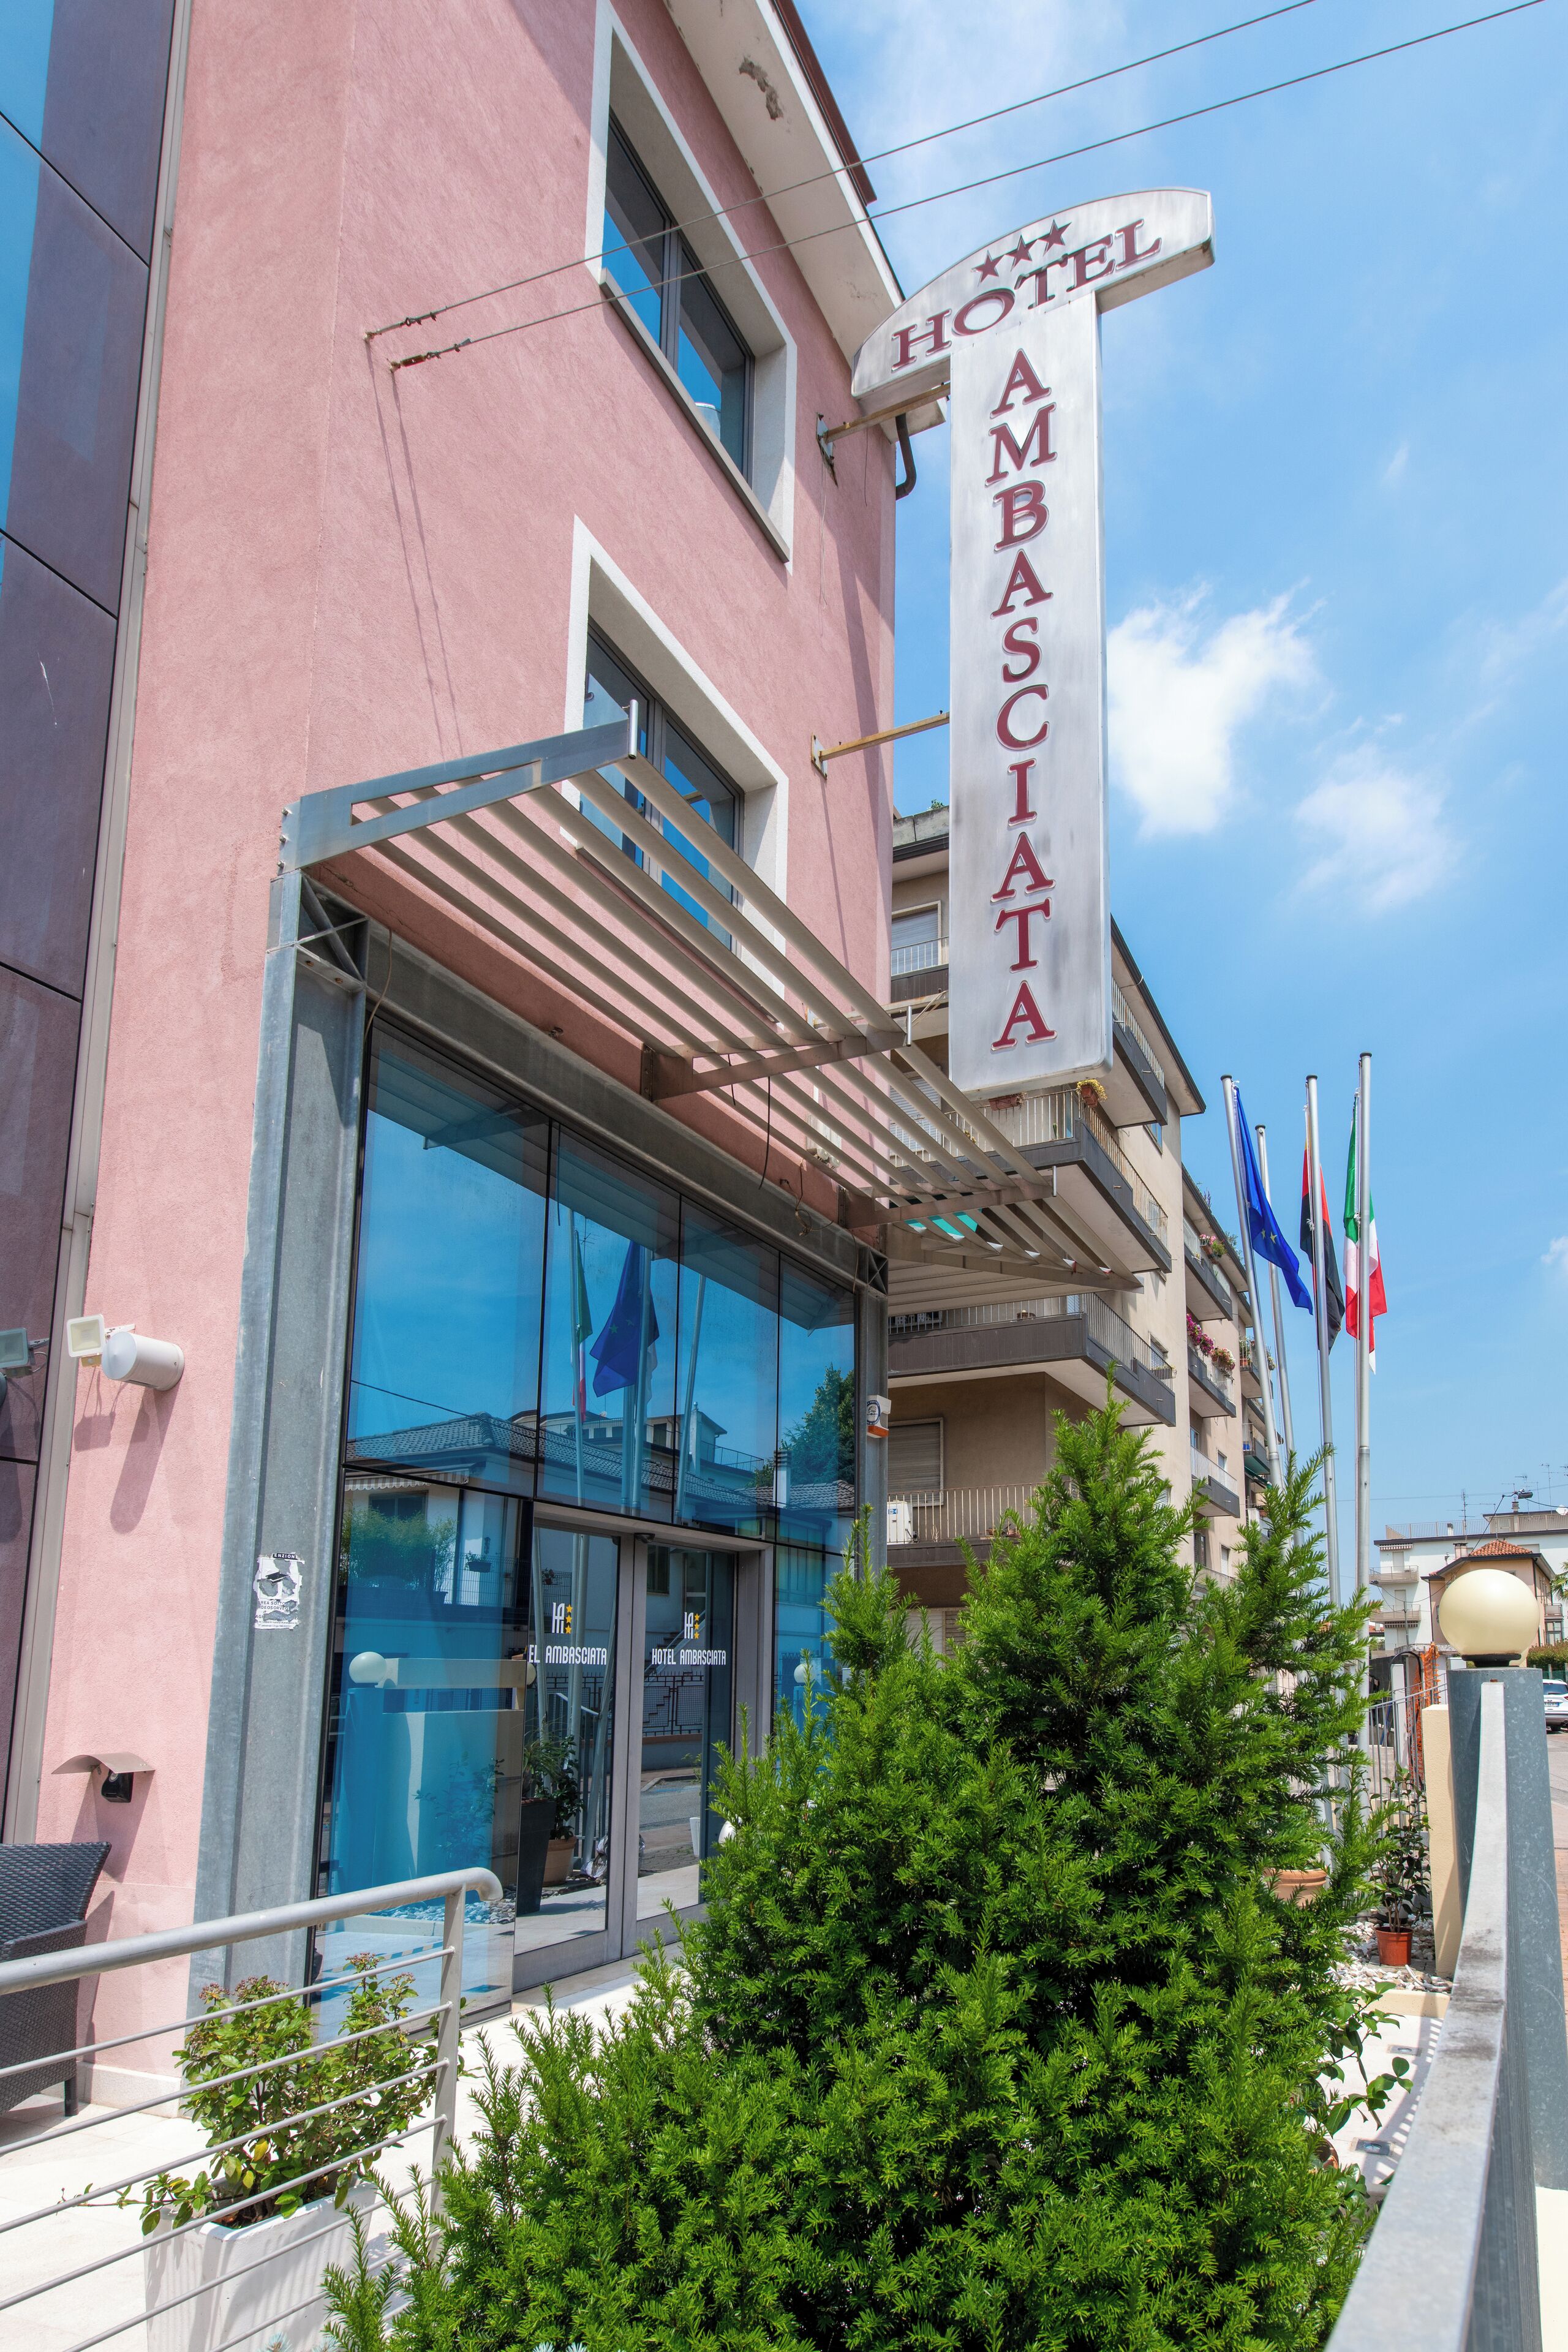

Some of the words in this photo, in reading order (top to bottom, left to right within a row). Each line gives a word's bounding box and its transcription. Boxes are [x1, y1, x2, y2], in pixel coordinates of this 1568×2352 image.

[891, 219, 1163, 373] HOTEL
[984, 347, 1058, 1052] AMBASCIATA
[545, 1645, 607, 1665] AMBASCIATA
[652, 1648, 676, 1665] HOTEL
[679, 1649, 726, 1665] AMBASCIATA
